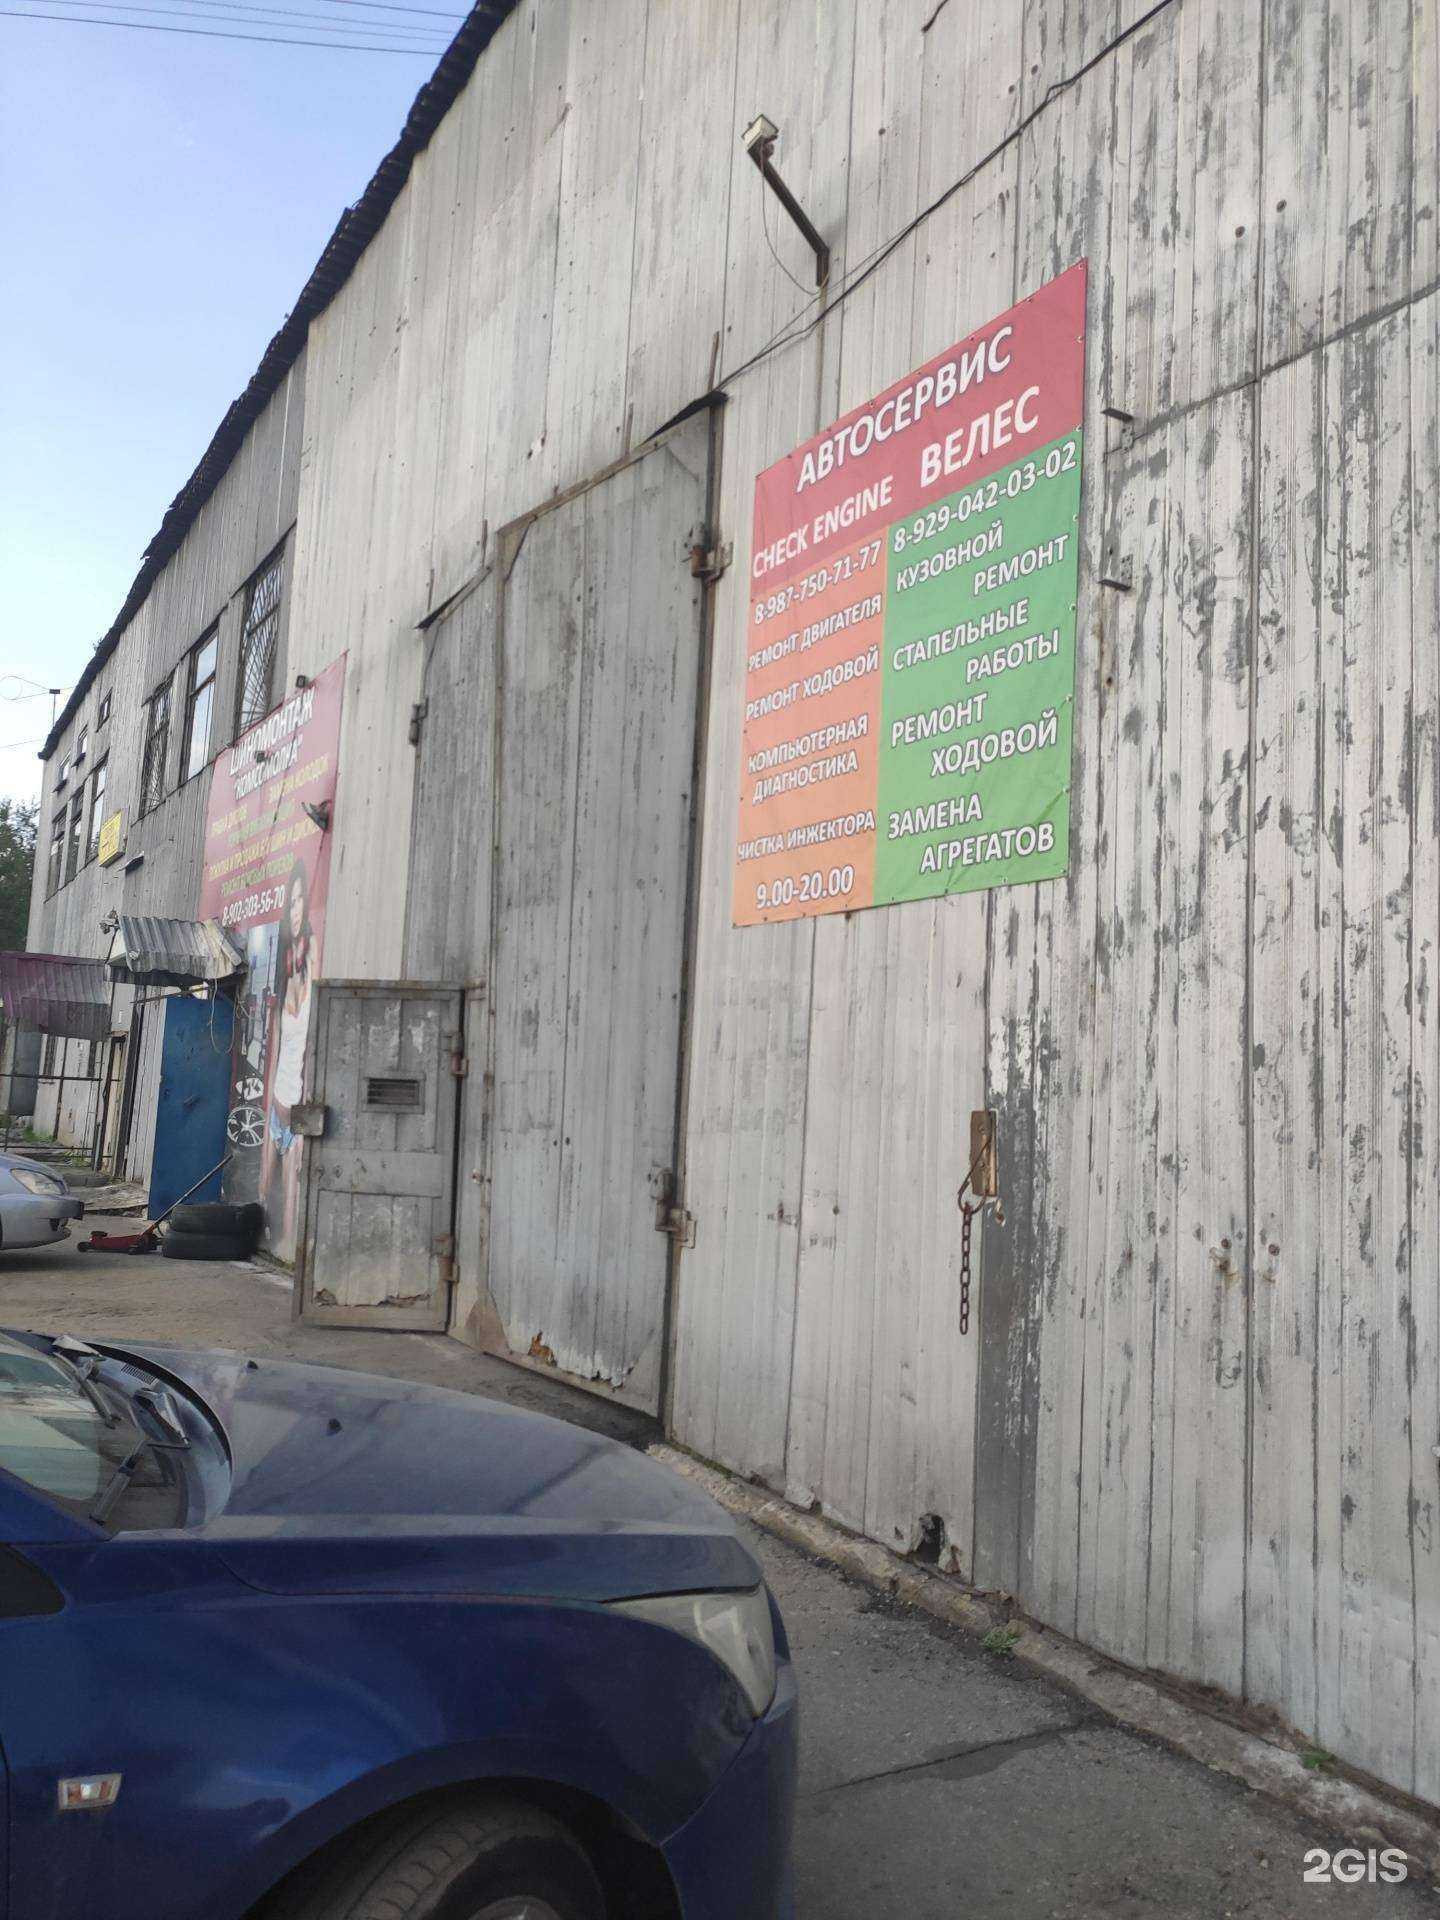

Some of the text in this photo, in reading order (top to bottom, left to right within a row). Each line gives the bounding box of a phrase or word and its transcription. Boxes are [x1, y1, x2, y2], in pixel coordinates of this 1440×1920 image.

[796, 326, 1013, 493] АВТОСЕРВИС
[920, 386, 1040, 488] ВЕЛЕС
[753, 475, 894, 579] CHECK ENGINE
[894, 441, 1077, 553] 8-929-042-03-02
[755, 541, 882, 625] 8-987-750-71-77
[896, 520, 1003, 592] КУЗОВНОЙ
[974, 534, 1070, 595] РЕМОНТ
[748, 594, 883, 672] РЕМОНТ ДВИГАТЕЛЯ
[893, 598, 1029, 671] СТАПЕЛЬНЫЕ
[966, 629, 1059, 683] РАБОТЫ
[745, 645, 879, 722] РЕМОНТ ХОДОВОЙ
[230, 686, 315, 776] ШИНОМОНТАЖ
[748, 714, 869, 774] КОМПЬЮТЕРНАЯ
[891, 693, 988, 747] РЕМОНТ
[931, 709, 1058, 777] ХОДОВОЙ
[753, 751, 858, 804] ДИАГНОСТИКА
[737, 810, 876, 861] ЧИСТКА ИНЖЕКТОРА
[888, 793, 982, 839] ЗАМЕНА
[919, 822, 1055, 873] АГРЕГАТОВ
[756, 865, 855, 909] 9.00-20.00
